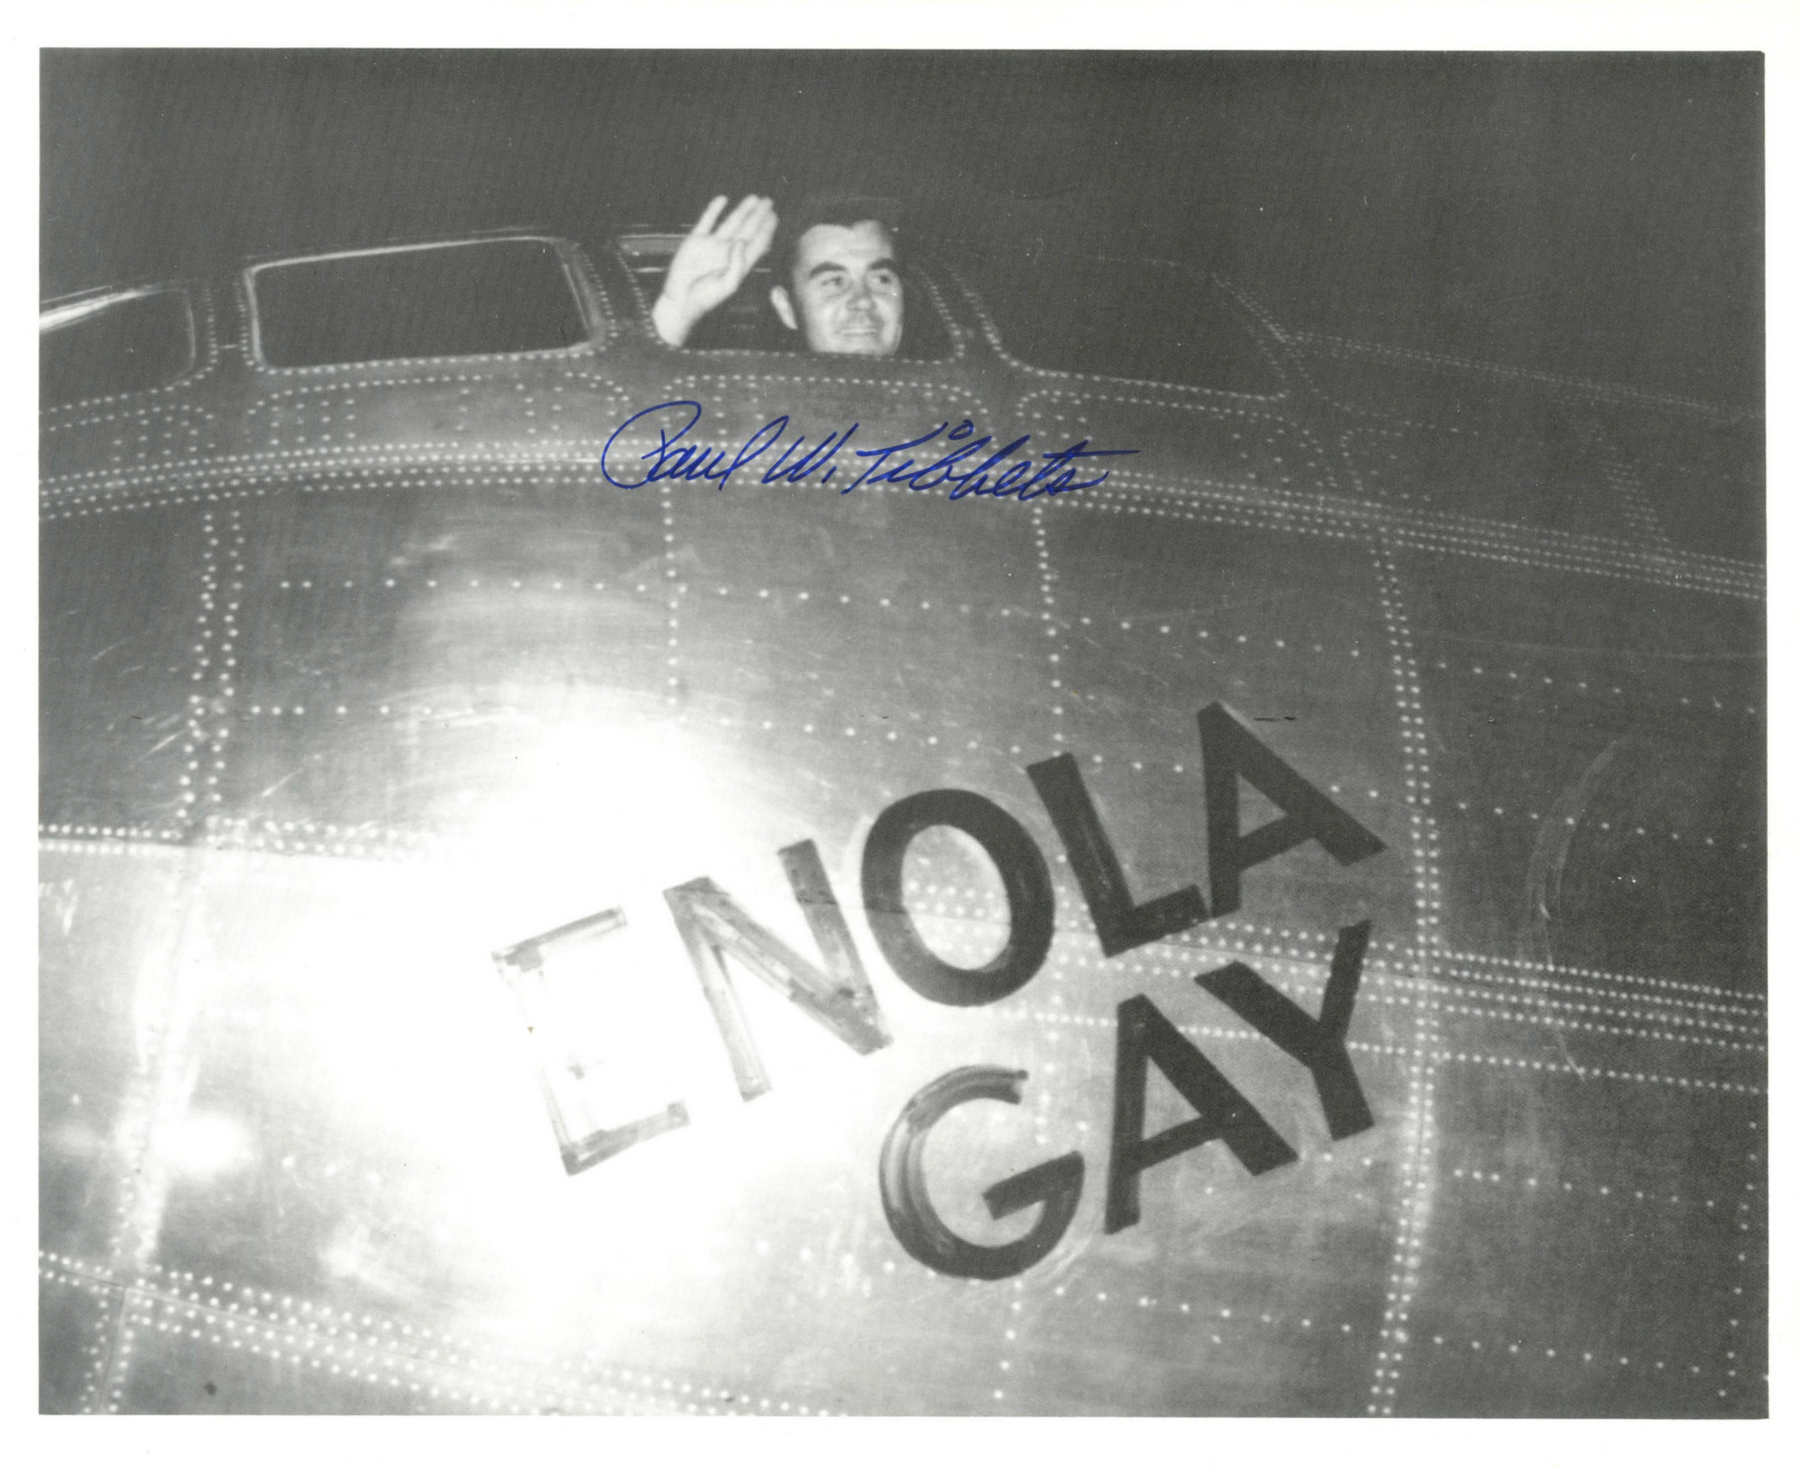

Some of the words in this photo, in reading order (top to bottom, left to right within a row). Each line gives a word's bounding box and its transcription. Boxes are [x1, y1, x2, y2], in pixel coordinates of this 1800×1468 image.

[601, 401, 790, 490] Paul
[842, 420, 1141, 500] Tibbets
[491, 701, 1388, 1176] ENOLA
[878, 919, 1374, 1280] GAY
